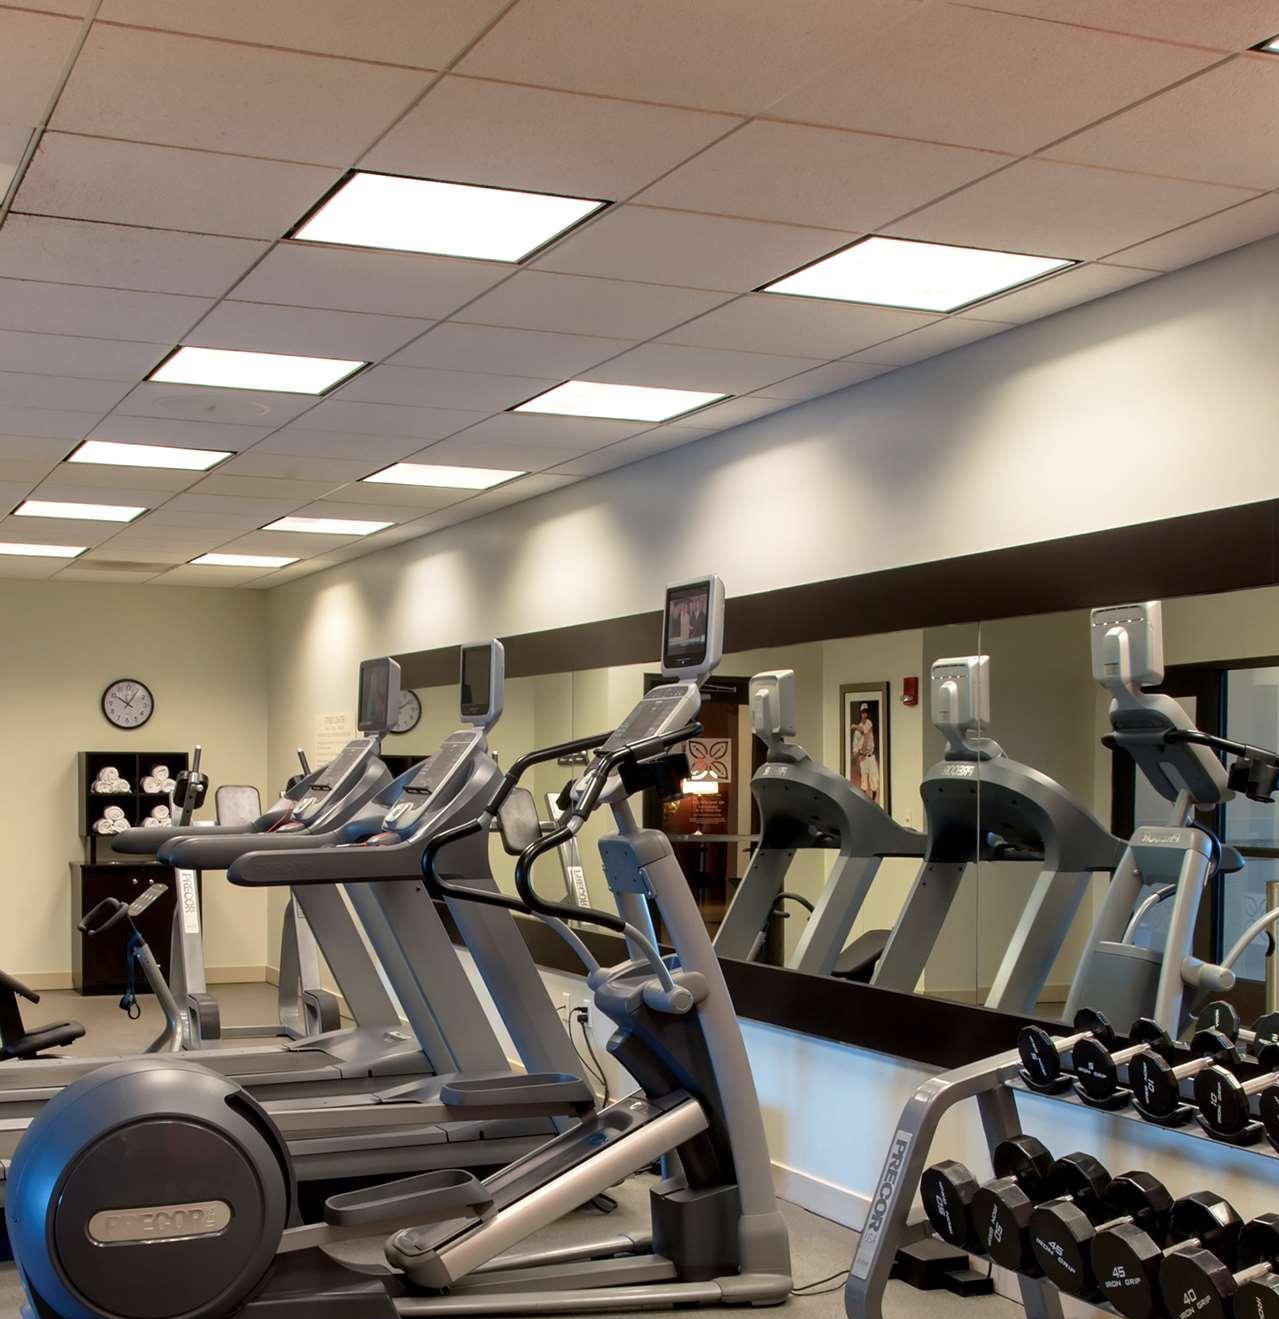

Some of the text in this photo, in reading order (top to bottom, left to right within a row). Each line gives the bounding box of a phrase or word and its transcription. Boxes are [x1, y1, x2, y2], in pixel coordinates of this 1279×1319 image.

[868, 1138, 908, 1233] PRECOR
[106, 1209, 204, 1237] PRECOR
[1048, 1241, 1064, 1256] 45
[1112, 1265, 1126, 1278] 45
[1105, 1277, 1141, 1288] IRON GRIP
[1183, 1288, 1197, 1305] 40
